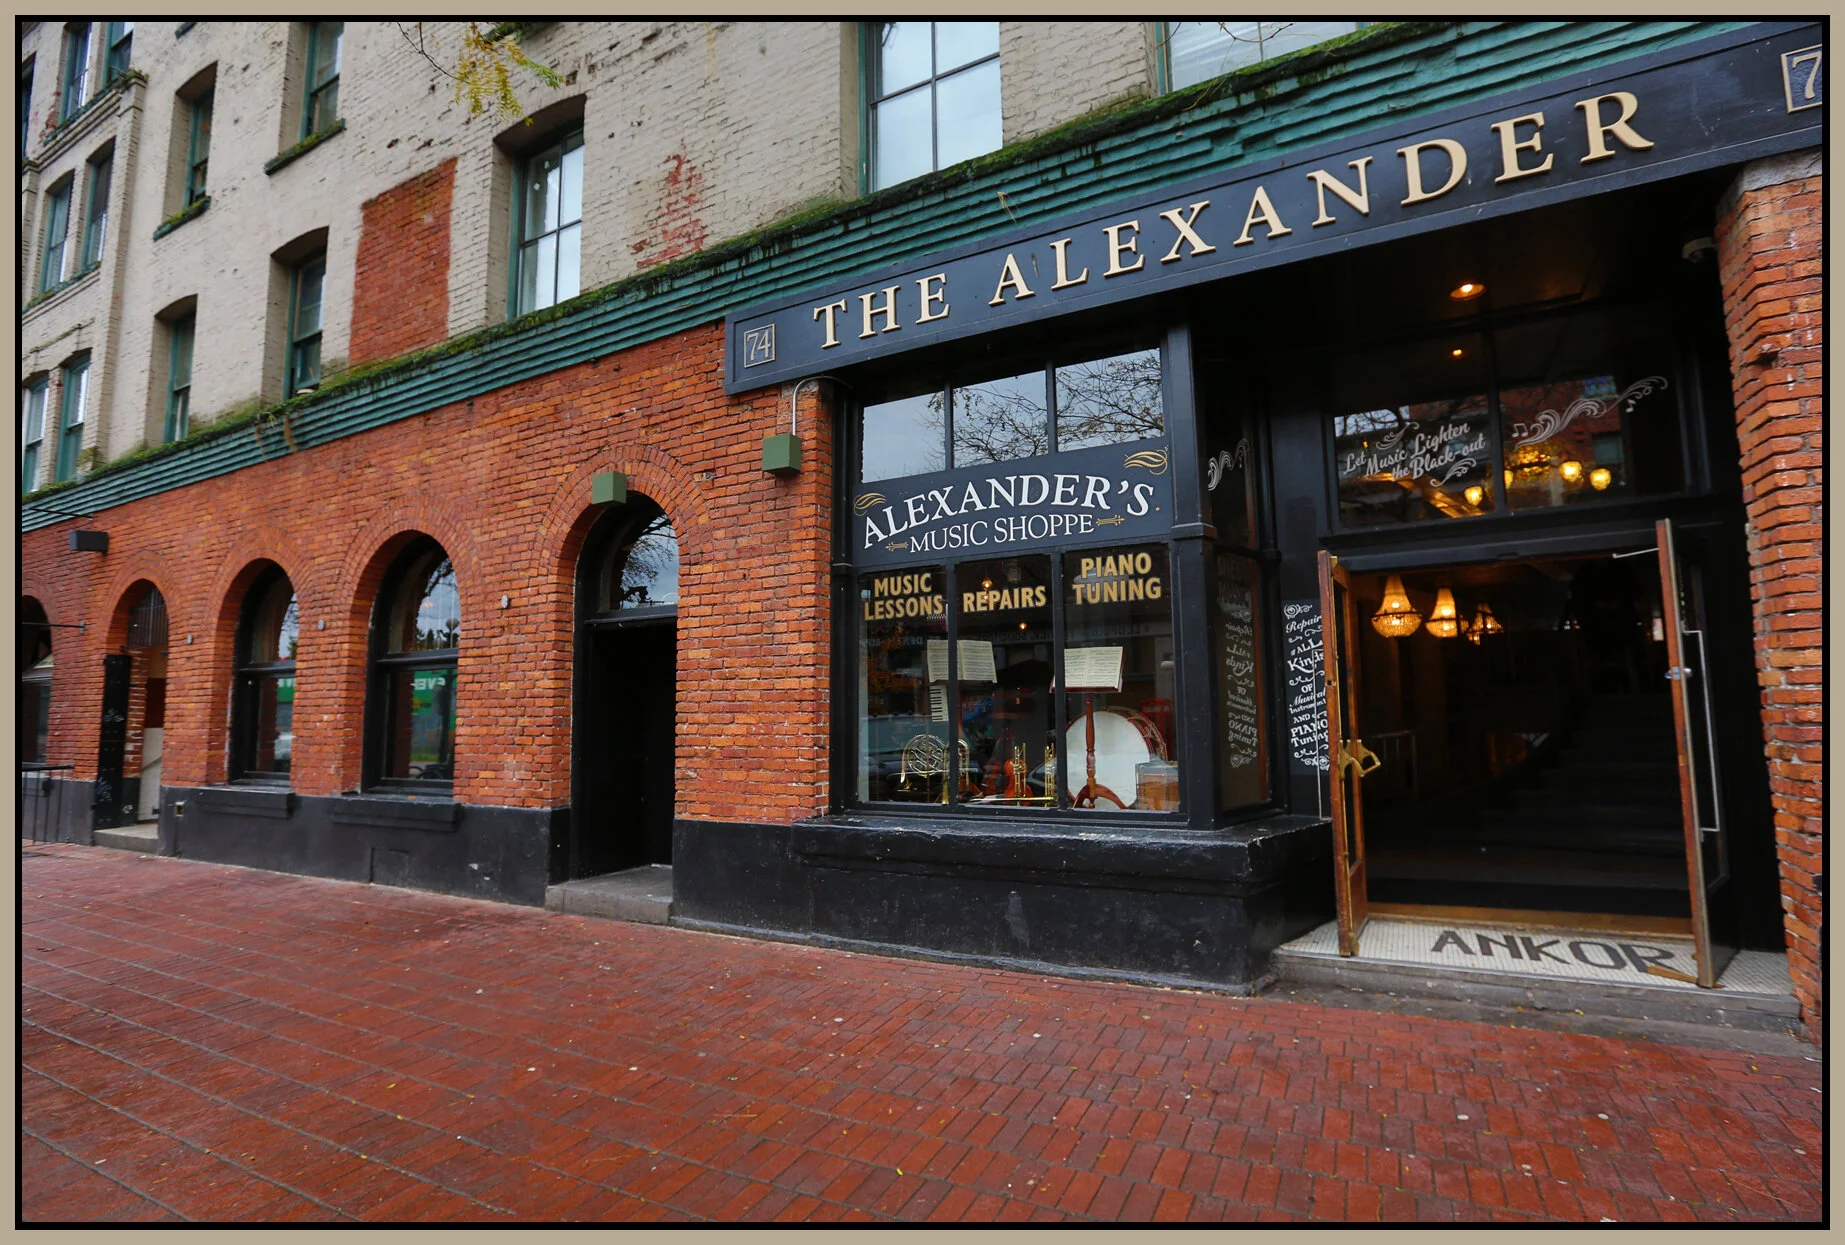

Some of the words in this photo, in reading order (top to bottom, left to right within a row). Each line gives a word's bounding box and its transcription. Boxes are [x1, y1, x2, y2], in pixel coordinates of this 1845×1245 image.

[813, 273, 951, 349] THE
[989, 90, 1655, 306] ALEXANDER
[747, 330, 771, 361] 74
[1343, 451, 1367, 475] Let
[1365, 449, 1408, 477] Music
[1410, 423, 1471, 459] Lighten
[1391, 465, 1411, 481] the
[1409, 433, 1486, 479] Black-out
[863, 474, 1154, 549] ALEXANDER'S
[910, 520, 989, 554] MUSIC
[993, 514, 1095, 542] SHOPPE
[1080, 552, 1153, 579] PIANO
[873, 573, 933, 598] MUSIC
[962, 585, 1047, 613] REPAIRS
[1071, 577, 1163, 606] TUNING
[863, 595, 944, 622] LESSONS
[1285, 615, 1322, 633] Repair
[1287, 651, 1324, 673] Kinds
[1290, 719, 1329, 738] PIANO
[1293, 713, 1311, 724] AND
[1290, 730, 1329, 747] Tuning
[1431, 930, 1680, 973] ANKOR
